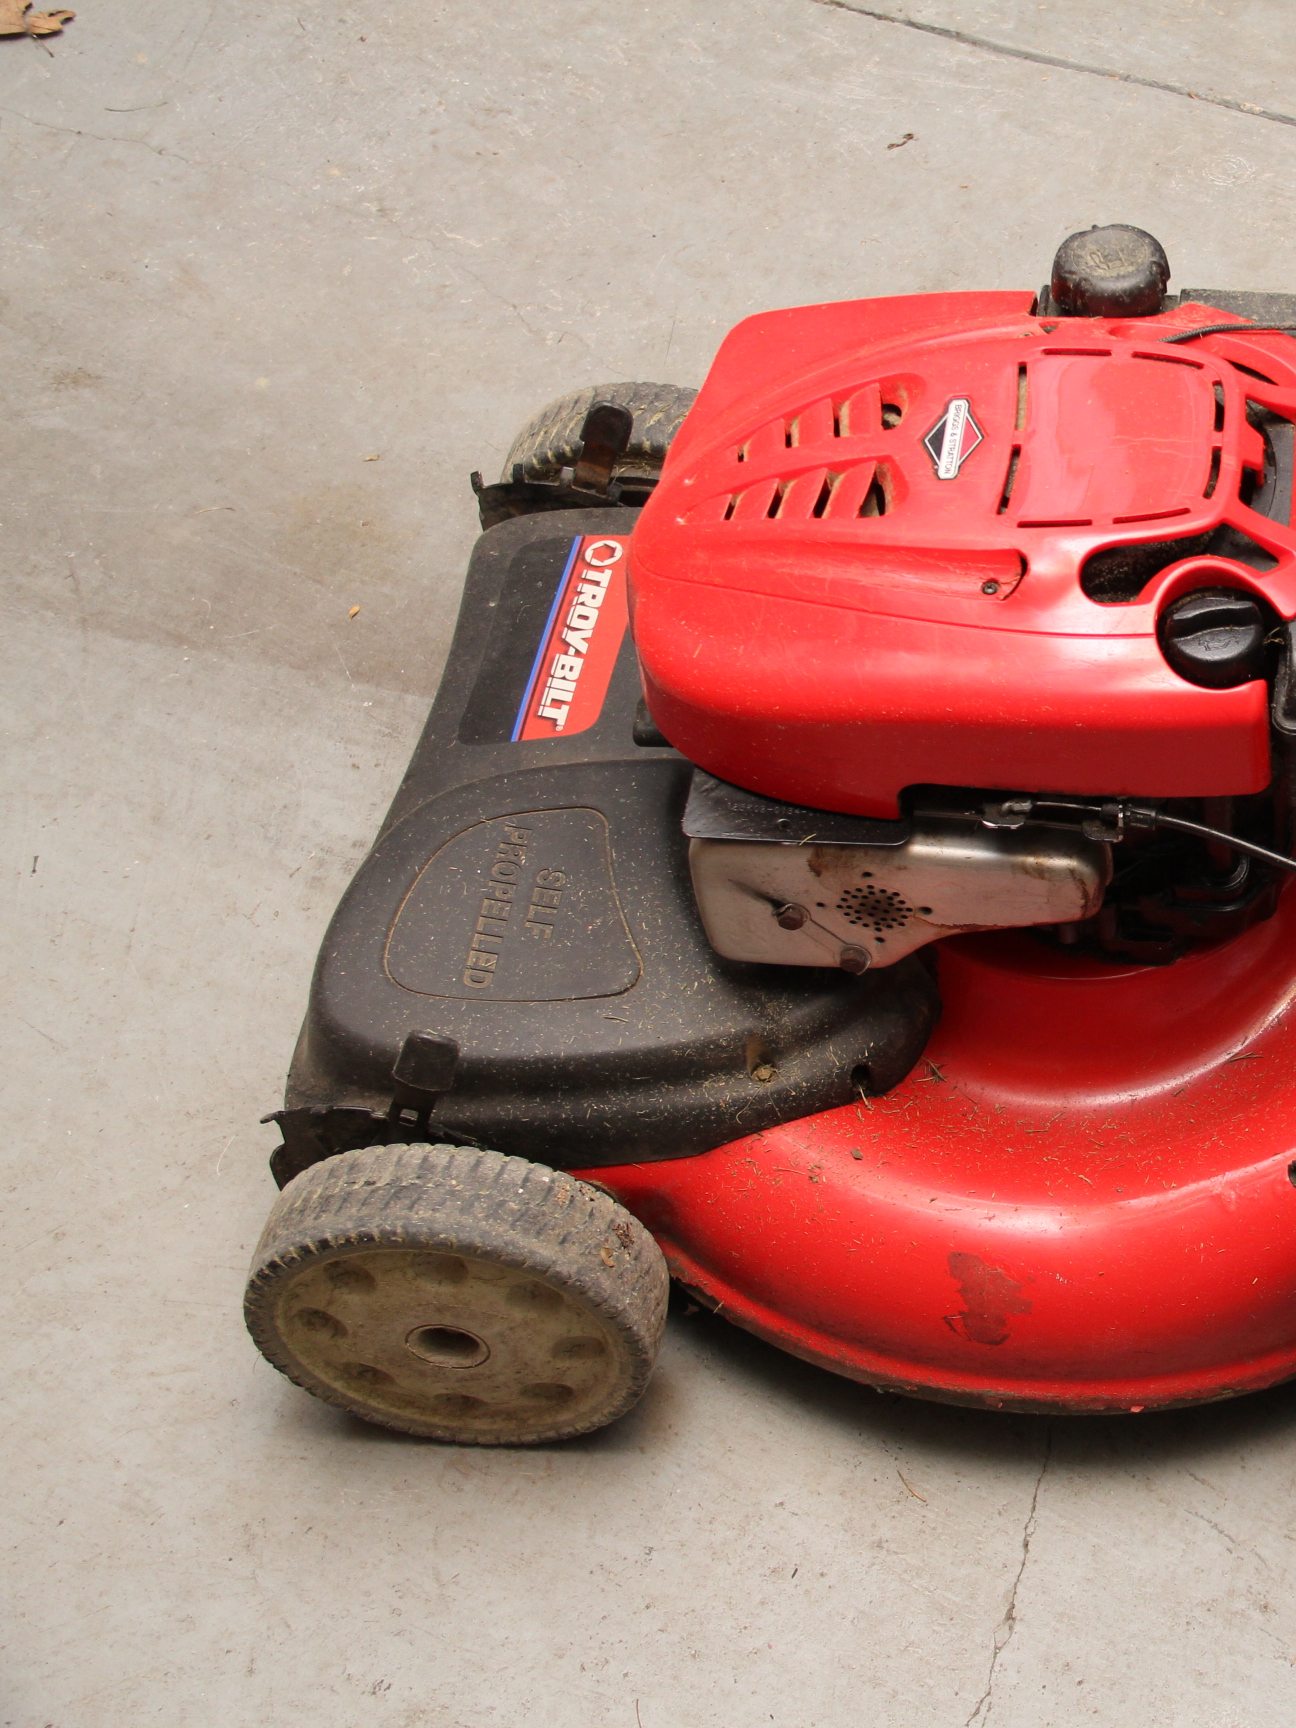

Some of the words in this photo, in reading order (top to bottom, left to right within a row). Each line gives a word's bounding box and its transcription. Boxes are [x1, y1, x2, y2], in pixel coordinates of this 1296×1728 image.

[951, 404, 962, 430] BRIGGS
[944, 439, 956, 474] STRATTON
[537, 569, 613, 726] TROY-BILT
[462, 825, 533, 989] PROPELLED
[524, 868, 567, 939] SELF
